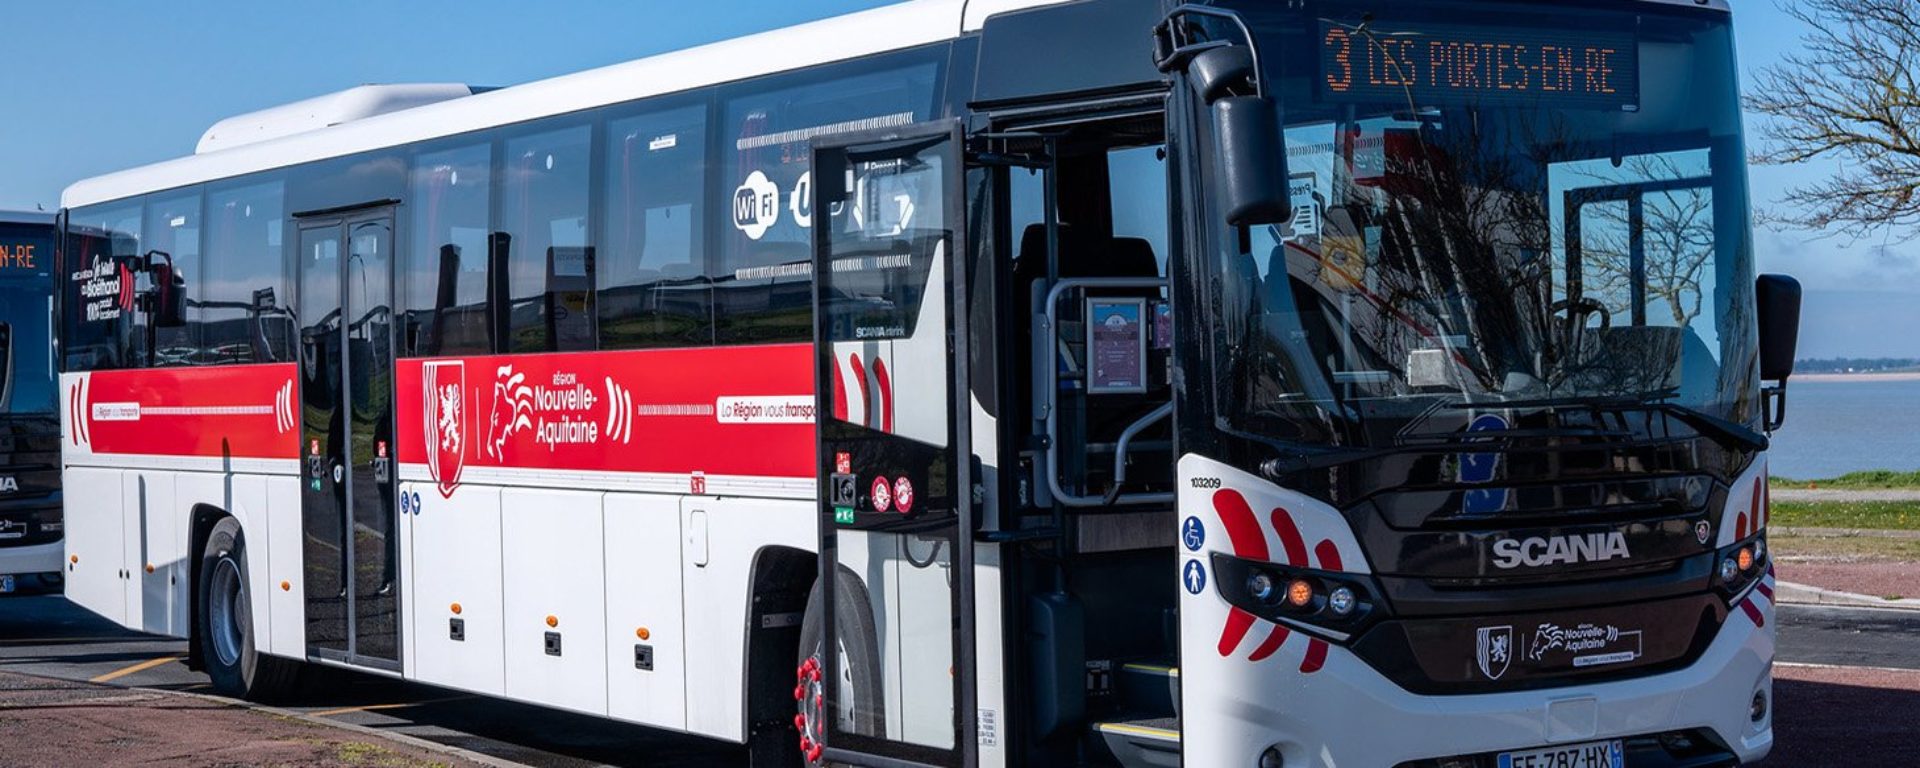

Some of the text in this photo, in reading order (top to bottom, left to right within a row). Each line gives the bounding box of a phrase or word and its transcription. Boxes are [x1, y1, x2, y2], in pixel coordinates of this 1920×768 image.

[1325, 29, 1616, 93] 3 LES PORTES-EN-RE
[535, 383, 598, 411] Nouvelle-
[721, 403, 732, 418] La
[733, 401, 763, 421] Région
[764, 405, 784, 417] vous
[536, 415, 598, 452] Aquitaine
[1190, 478, 1221, 488] 103209
[1492, 531, 1630, 569] SCANIA
[1565, 638, 1606, 652] Aquitaine
